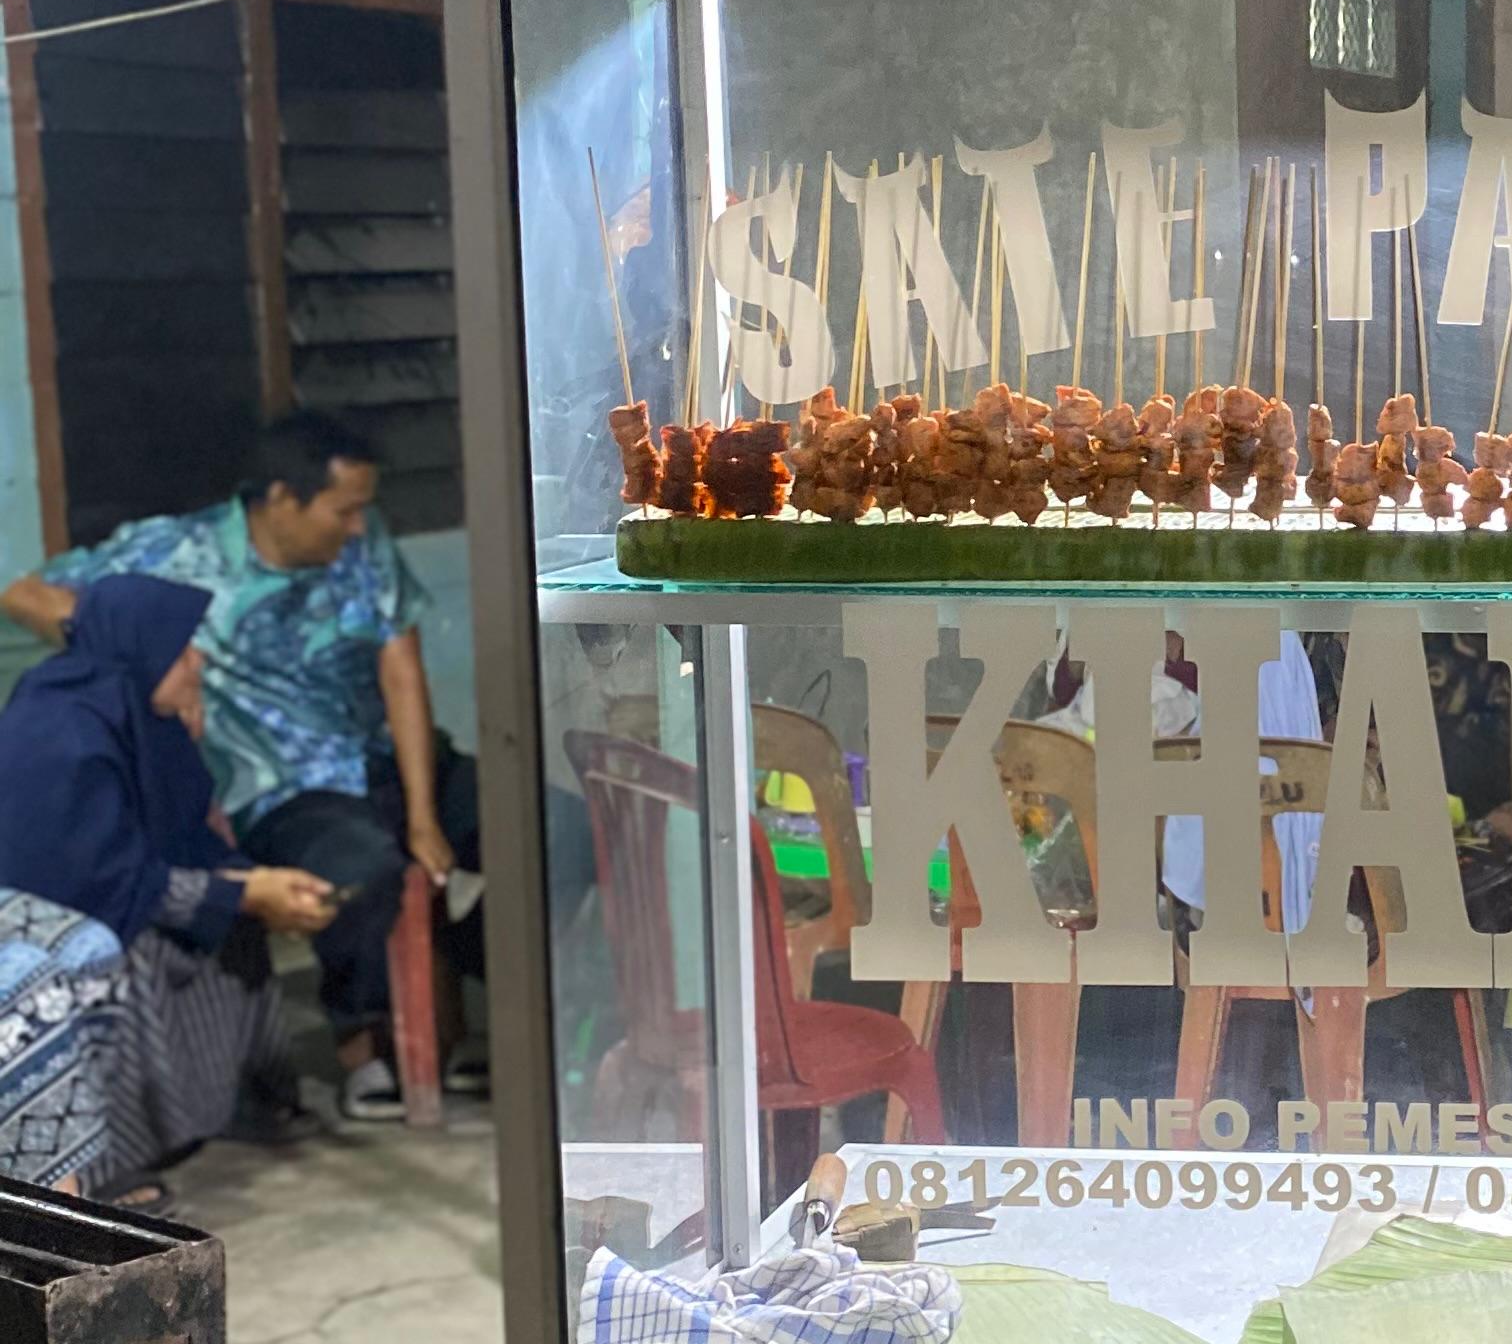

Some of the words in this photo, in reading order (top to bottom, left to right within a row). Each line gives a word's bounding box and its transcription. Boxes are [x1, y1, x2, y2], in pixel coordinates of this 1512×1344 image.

[708, 114, 1216, 406] SATE
[1072, 1096, 1252, 1152] INFO
[863, 1158, 1398, 1213] 081264099493
[1421, 1164, 1441, 1214] /
